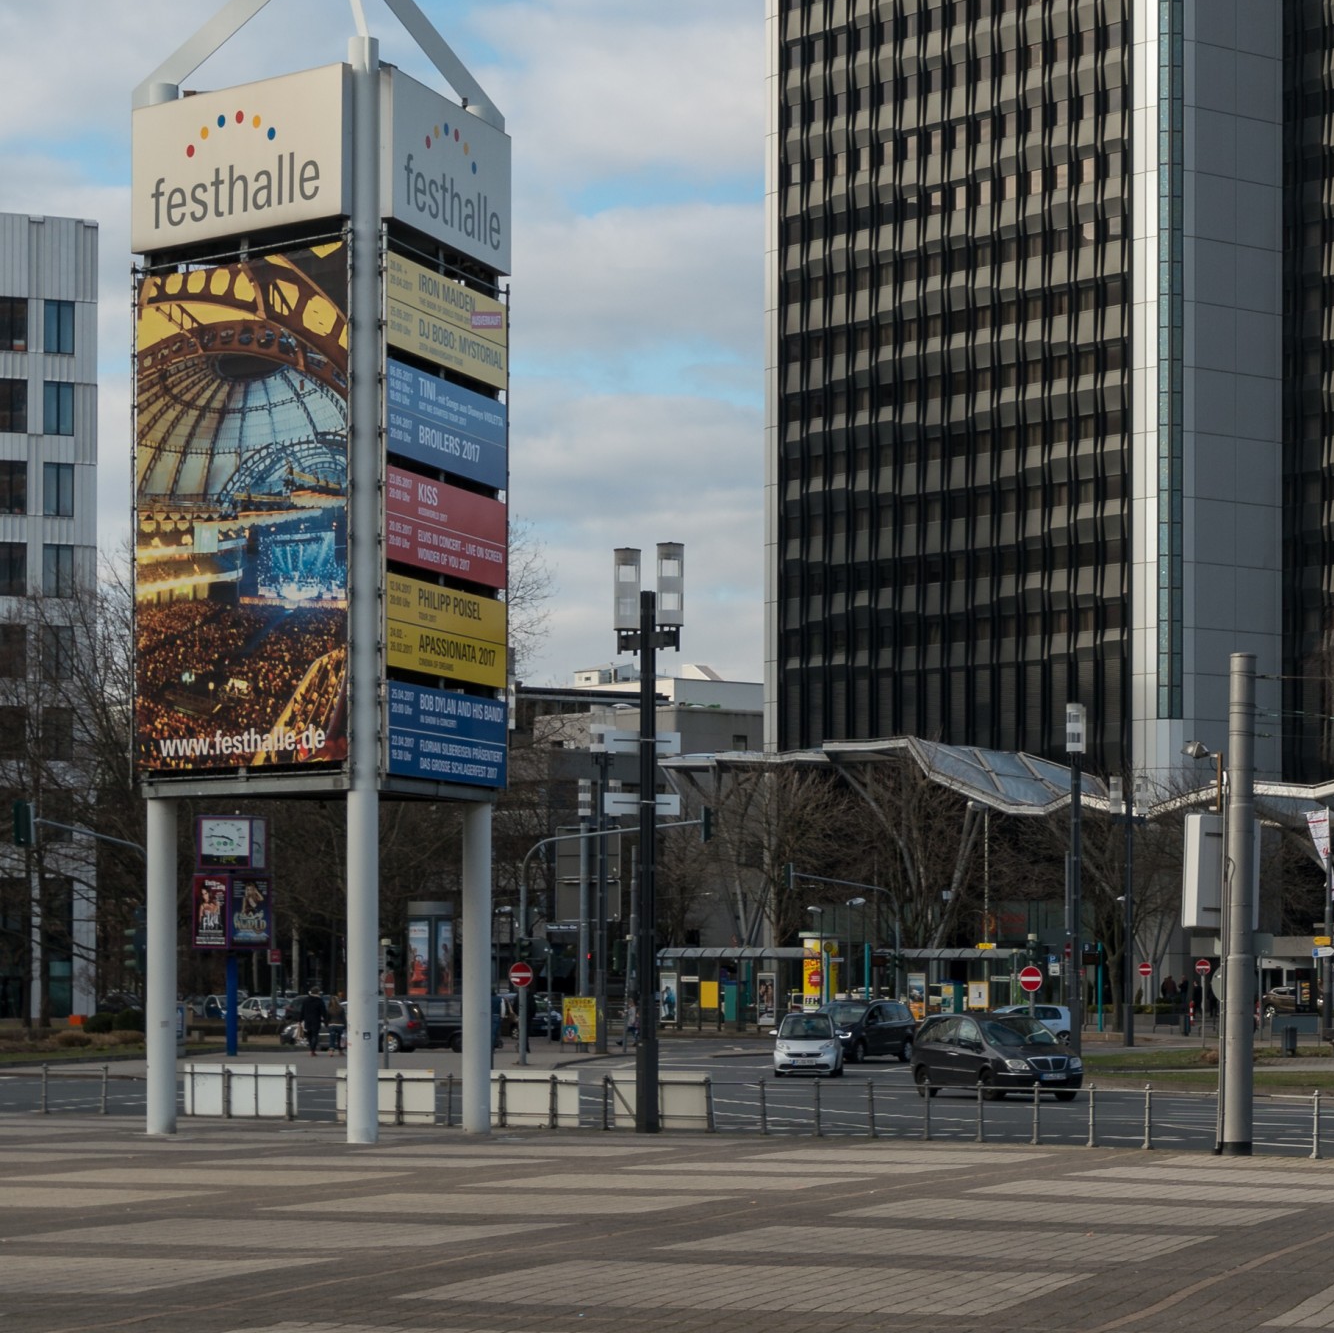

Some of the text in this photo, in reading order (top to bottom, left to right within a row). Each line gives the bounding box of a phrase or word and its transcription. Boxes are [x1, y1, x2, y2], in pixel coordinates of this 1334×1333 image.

[151, 152, 320, 229] festhalle
[404, 153, 501, 250] festhalle
[419, 273, 475, 314] IRON MAIDEN
[419, 319, 503, 370] DJ BOBO: MYSTORIAL
[419, 378, 436, 401] TINI
[446, 397, 459, 412] Songs
[484, 412, 503, 427] VIOLETTA
[419, 425, 480, 463] BROILERS 2017
[418, 483, 438, 506] KISS
[418, 530, 431, 544] ELVIS
[433, 534, 438, 545] IN
[439, 536, 461, 552] CONCERT
[466, 543, 476, 556] LIVE
[477, 546, 484, 558] ON
[485, 549, 503, 563] SCREEN
[418, 548, 470, 571] WONDER OF YOU 2017
[419, 588, 482, 621] PHILIPP POISEL
[419, 634, 496, 667] APASSIONATA 2017
[405, 706, 413, 715] Uhr
[420, 694, 434, 710] BOB
[436, 697, 456, 714] DYLAN
[458, 701, 471, 717] AND
[473, 704, 483, 719] HIS
[160, 724, 326, 757] www.festhalle.de
[404, 752, 412, 761] Uhr
[420, 740, 503, 763] FLORIAN SILBEREISEN PRÄSENTIERT
[420, 758, 497, 779] DAS GROSSE SCHLAGERFEST 2017
